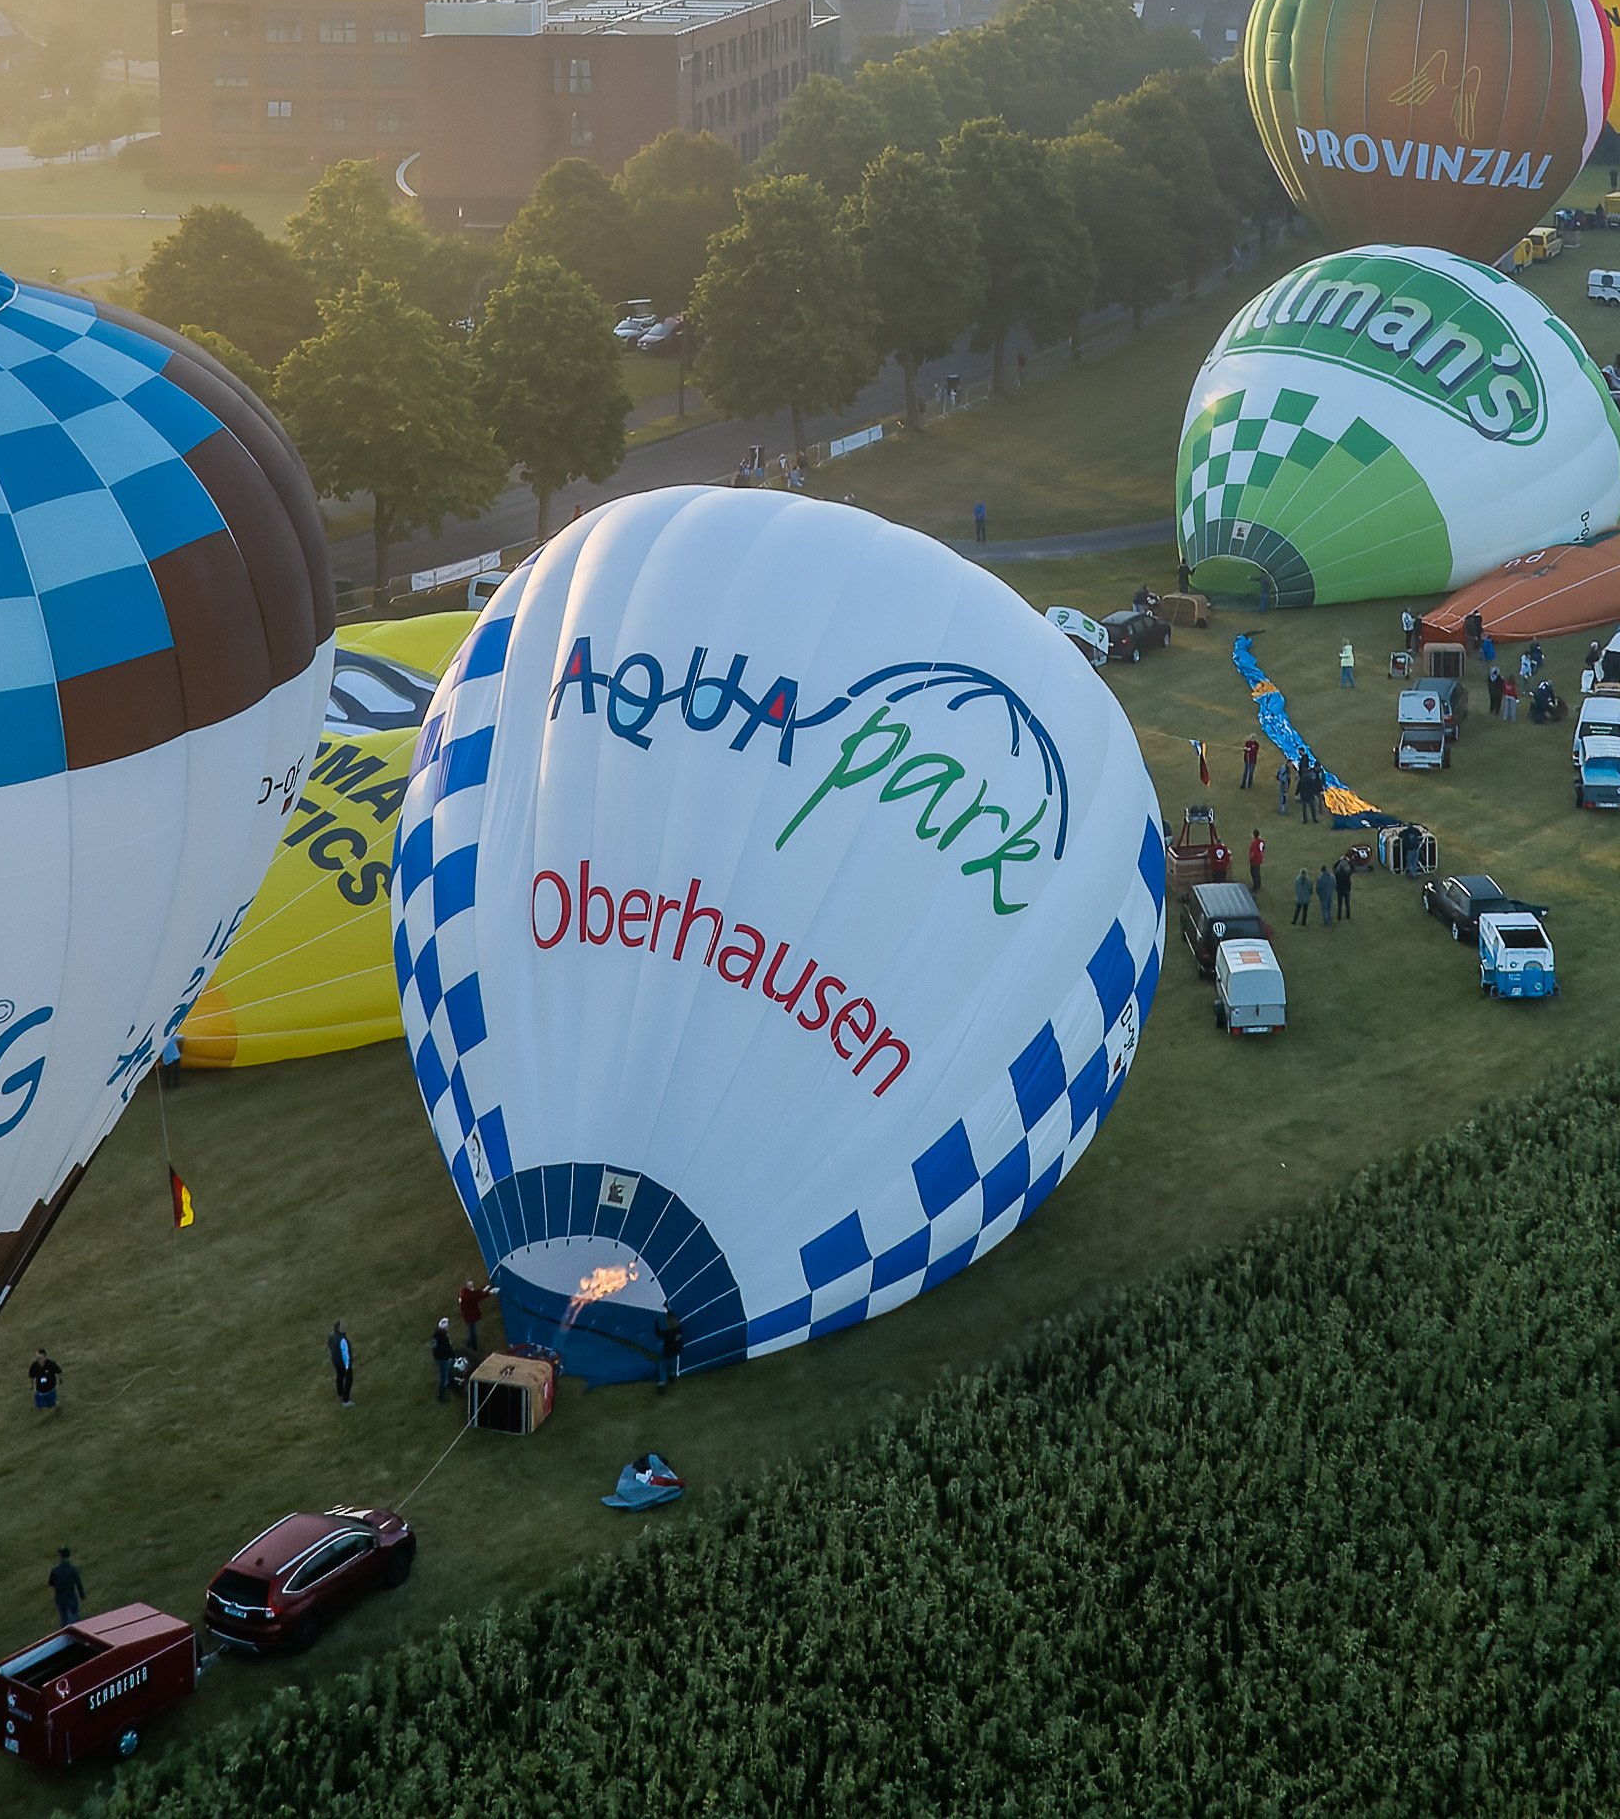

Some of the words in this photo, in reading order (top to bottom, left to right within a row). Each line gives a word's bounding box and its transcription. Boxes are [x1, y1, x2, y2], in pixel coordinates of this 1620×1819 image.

[1296, 126, 1552, 190] PROVINZIAL
[548, 636, 800, 767] AQUA
[776, 706, 1048, 915] park
[532, 860, 910, 1097] Oberhausen
[89, 1666, 148, 1711] SCHROEDER
